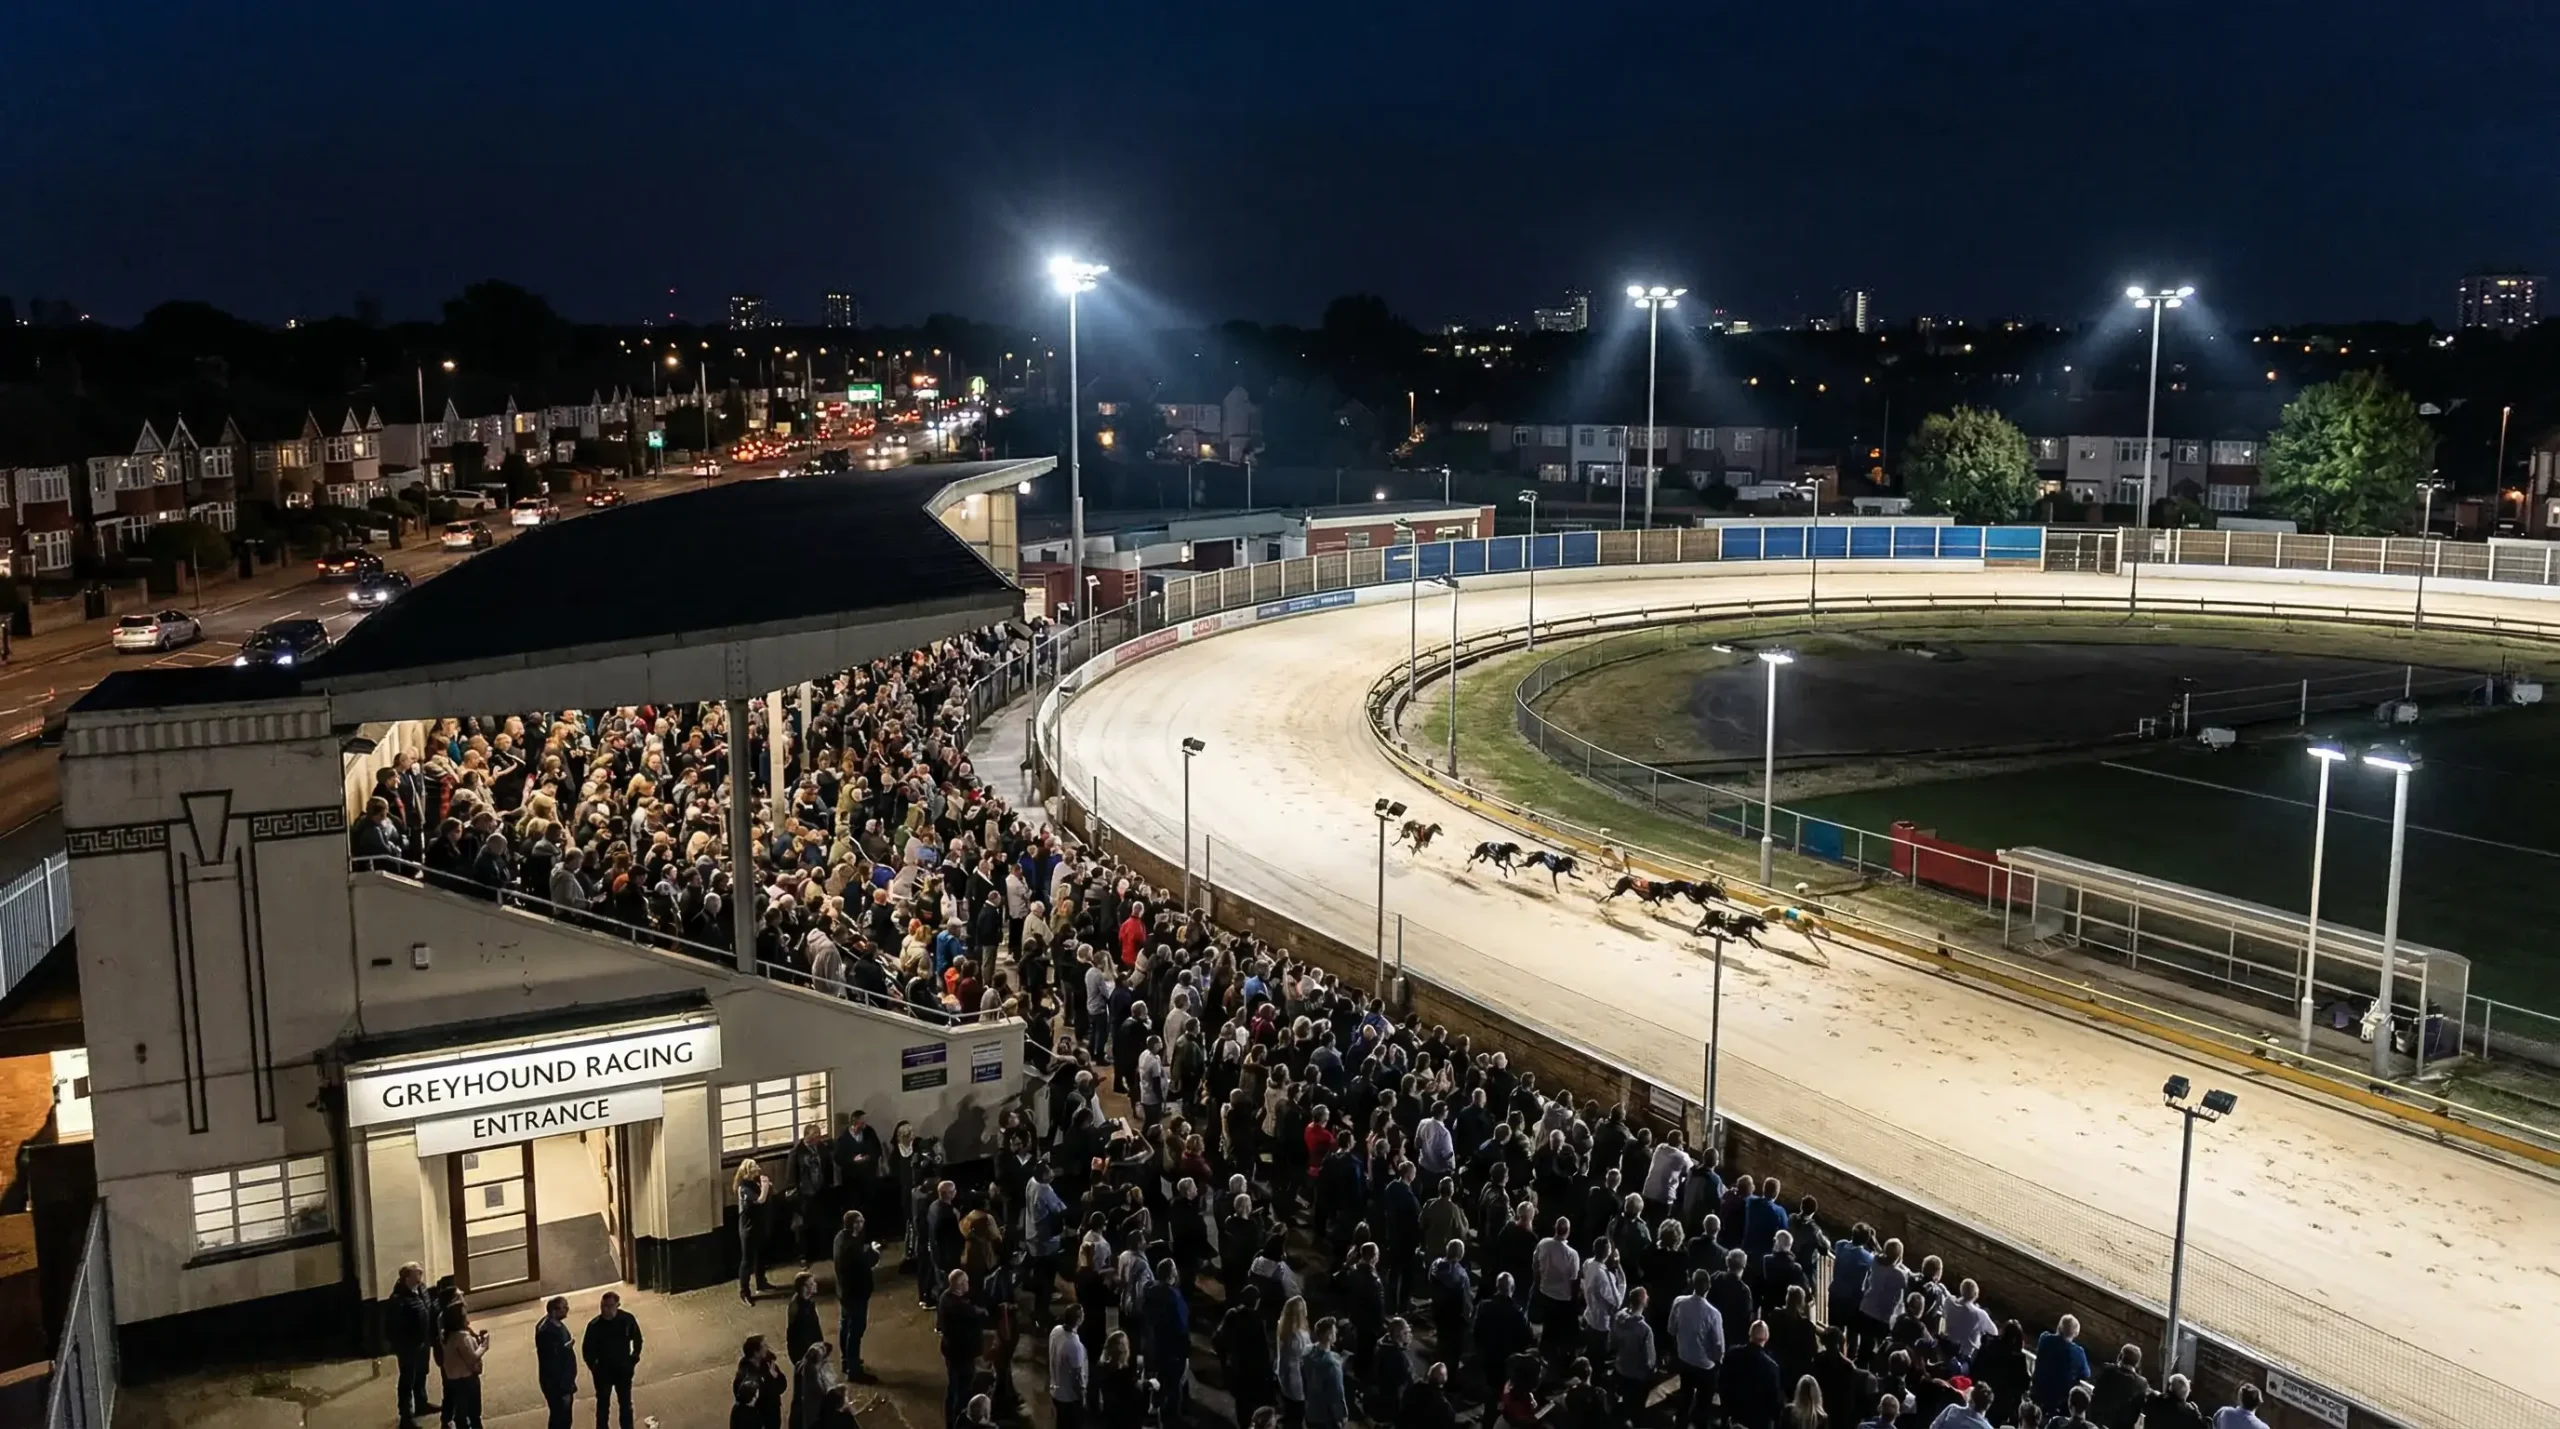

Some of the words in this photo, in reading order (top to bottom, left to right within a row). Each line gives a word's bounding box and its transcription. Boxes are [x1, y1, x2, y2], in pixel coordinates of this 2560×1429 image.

[382, 1060, 576, 1108] GREYHOUND
[586, 1042, 693, 1076] RACING
[473, 1098, 610, 1138] ENTRANCE
